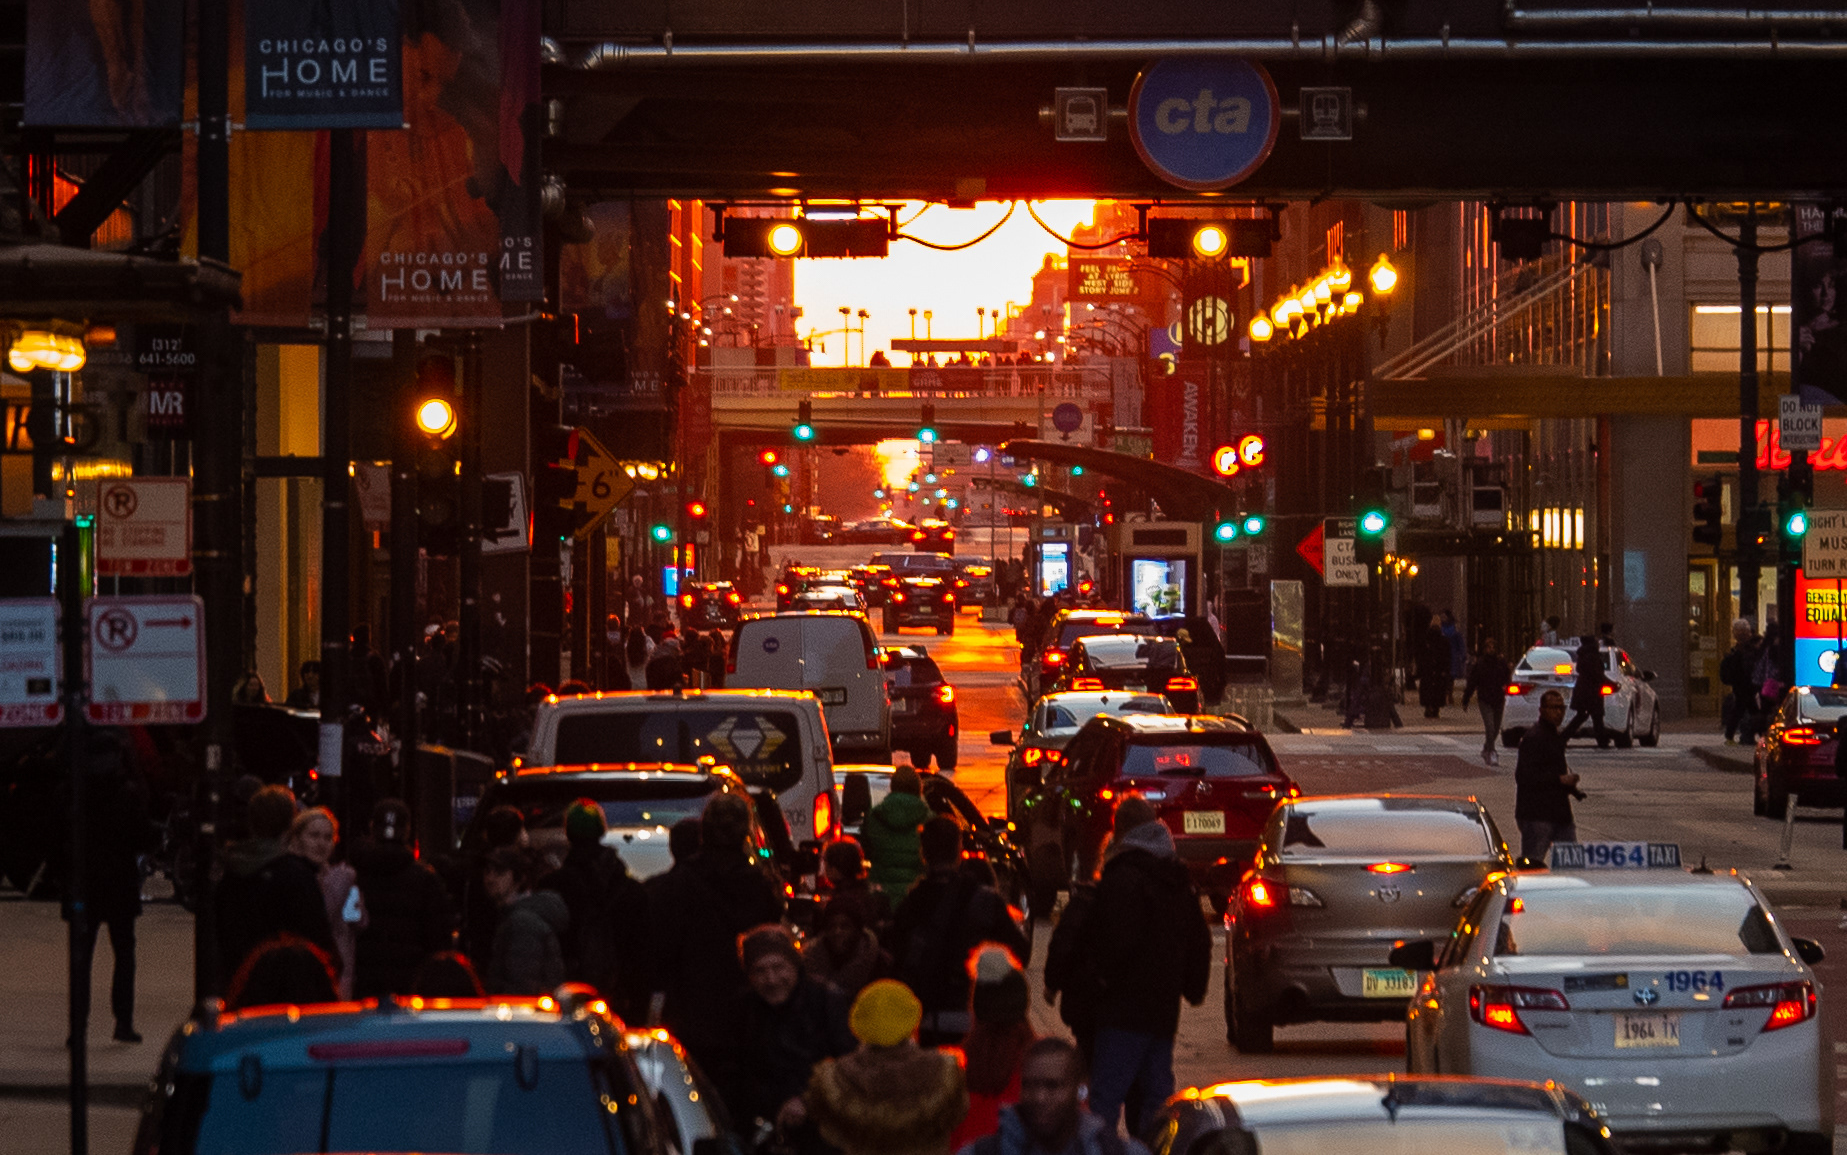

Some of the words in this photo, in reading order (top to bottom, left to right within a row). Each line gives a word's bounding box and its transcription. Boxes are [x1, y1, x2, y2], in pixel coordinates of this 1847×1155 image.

[259, 37, 388, 54] CHICAGO'S
[262, 57, 388, 98] HOME
[296, 89, 334, 97] MUSIC
[351, 89, 389, 97] DANCE
[1155, 88, 1251, 134] cta
[380, 252, 489, 264] CHICAGO'S
[381, 267, 488, 302] HOME
[1084, 279, 1107, 287] WEST
[1113, 279, 1133, 287] SIDE
[1079, 286, 1107, 295] STORY
[1109, 286, 1131, 295] JUNE
[152, 337, 182, 351] (312)
[139, 352, 196, 365] 641-5600
[1783, 401, 1797, 413] DO
[1783, 419, 1819, 431] BLOCK
[1809, 559, 1836, 571] TURN
[1335, 570, 1361, 580] ONLY
[1556, 847, 1584, 865] TAXI
[1585, 844, 1644, 866] 1964
[1649, 846, 1677, 866] TAXI
[1664, 970, 1724, 993] 1964
[1624, 1018, 1656, 1039] 1964
